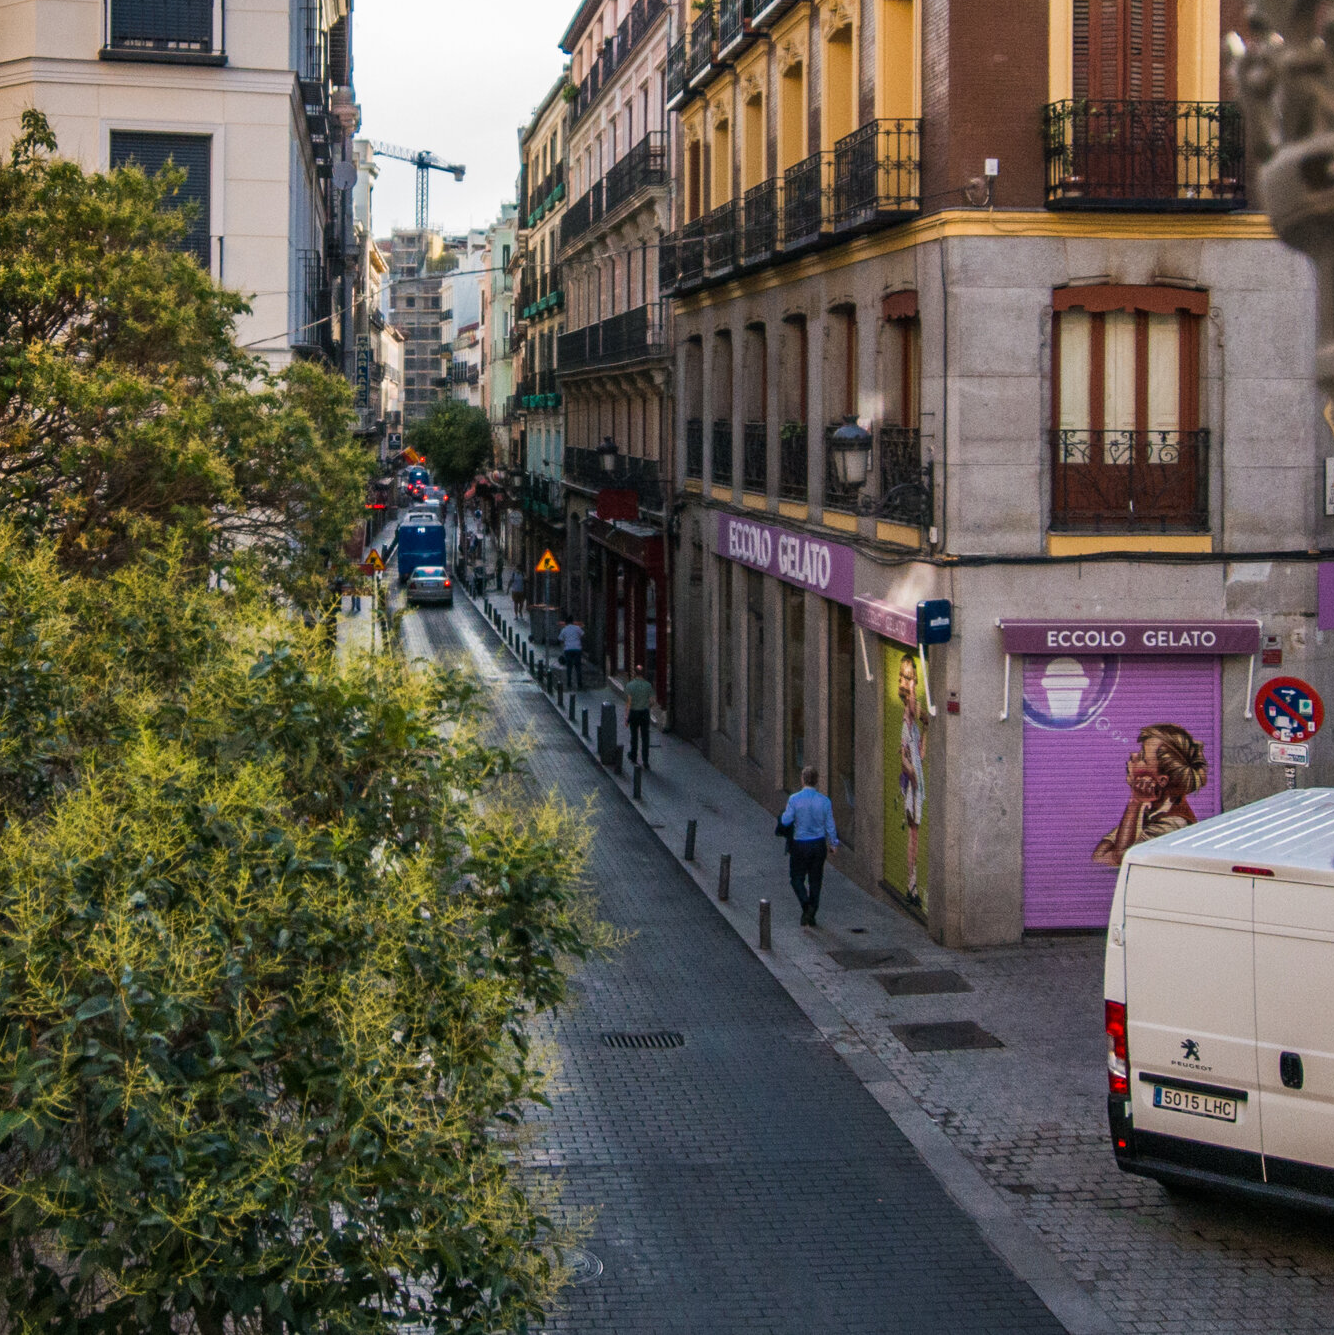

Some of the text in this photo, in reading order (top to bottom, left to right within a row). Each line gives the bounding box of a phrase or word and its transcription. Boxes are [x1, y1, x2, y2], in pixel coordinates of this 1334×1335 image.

[729, 520, 831, 590] ECCOLO GELATO
[1047, 631, 1216, 647] ECCOLO GELATO
[1171, 1059, 1213, 1072] PEUGEOT
[1164, 1090, 1200, 1110] 5015
[1204, 1098, 1232, 1117] LHC
